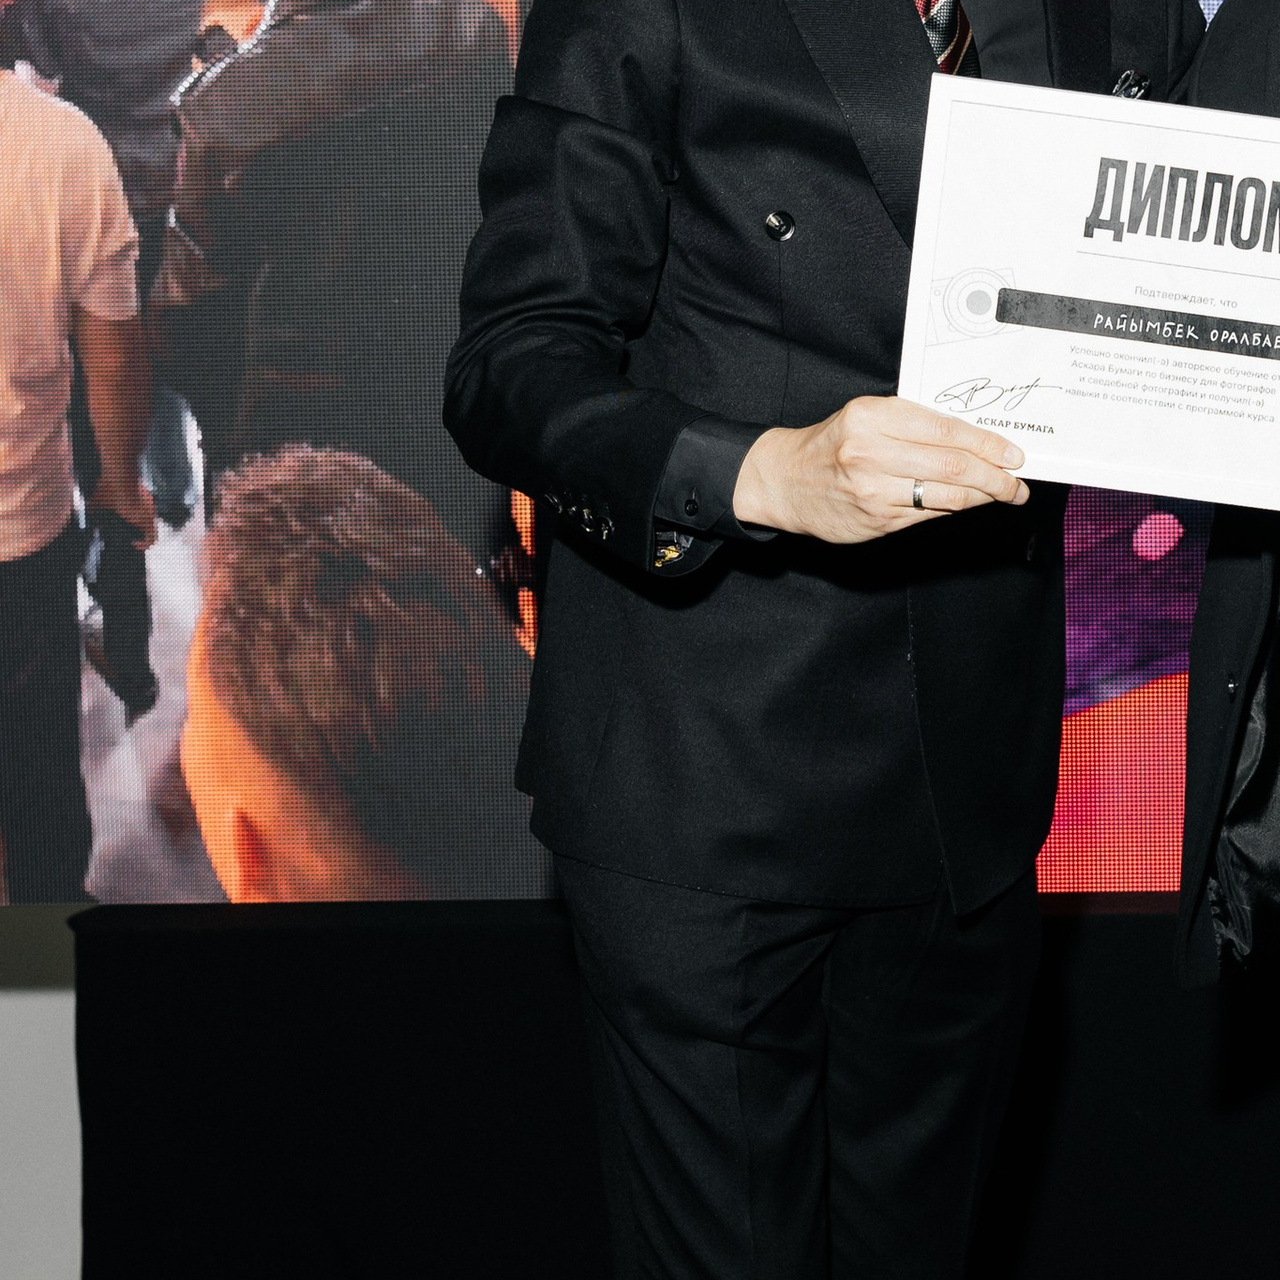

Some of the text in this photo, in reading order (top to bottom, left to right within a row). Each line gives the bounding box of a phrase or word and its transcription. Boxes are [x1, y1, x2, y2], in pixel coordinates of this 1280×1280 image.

[1134, 286, 1238, 309] Подтверждает, что
[1094, 313, 1199, 340] РАЙЫМБЕК
[1070, 345, 1111, 359] Успешно
[1113, 352, 1170, 367] окончил(-а)
[1172, 359, 1221, 373] авторское
[1224, 366, 1269, 380] обучение
[1071, 360, 1277, 396] Аскара Бумаги по бизнесу для фотографов
[1065, 388, 1100, 399] навыки
[1111, 394, 1176, 409] соответствии
[1178, 403, 1184, 411] с
[1186, 403, 1245, 418] программой
[1247, 411, 1275, 423] курса
[1141, 384, 1198, 399] фотографии
[1209, 393, 1265, 408] получил(-а)
[976, 417, 1055, 434] АСКАР БУМАГА
